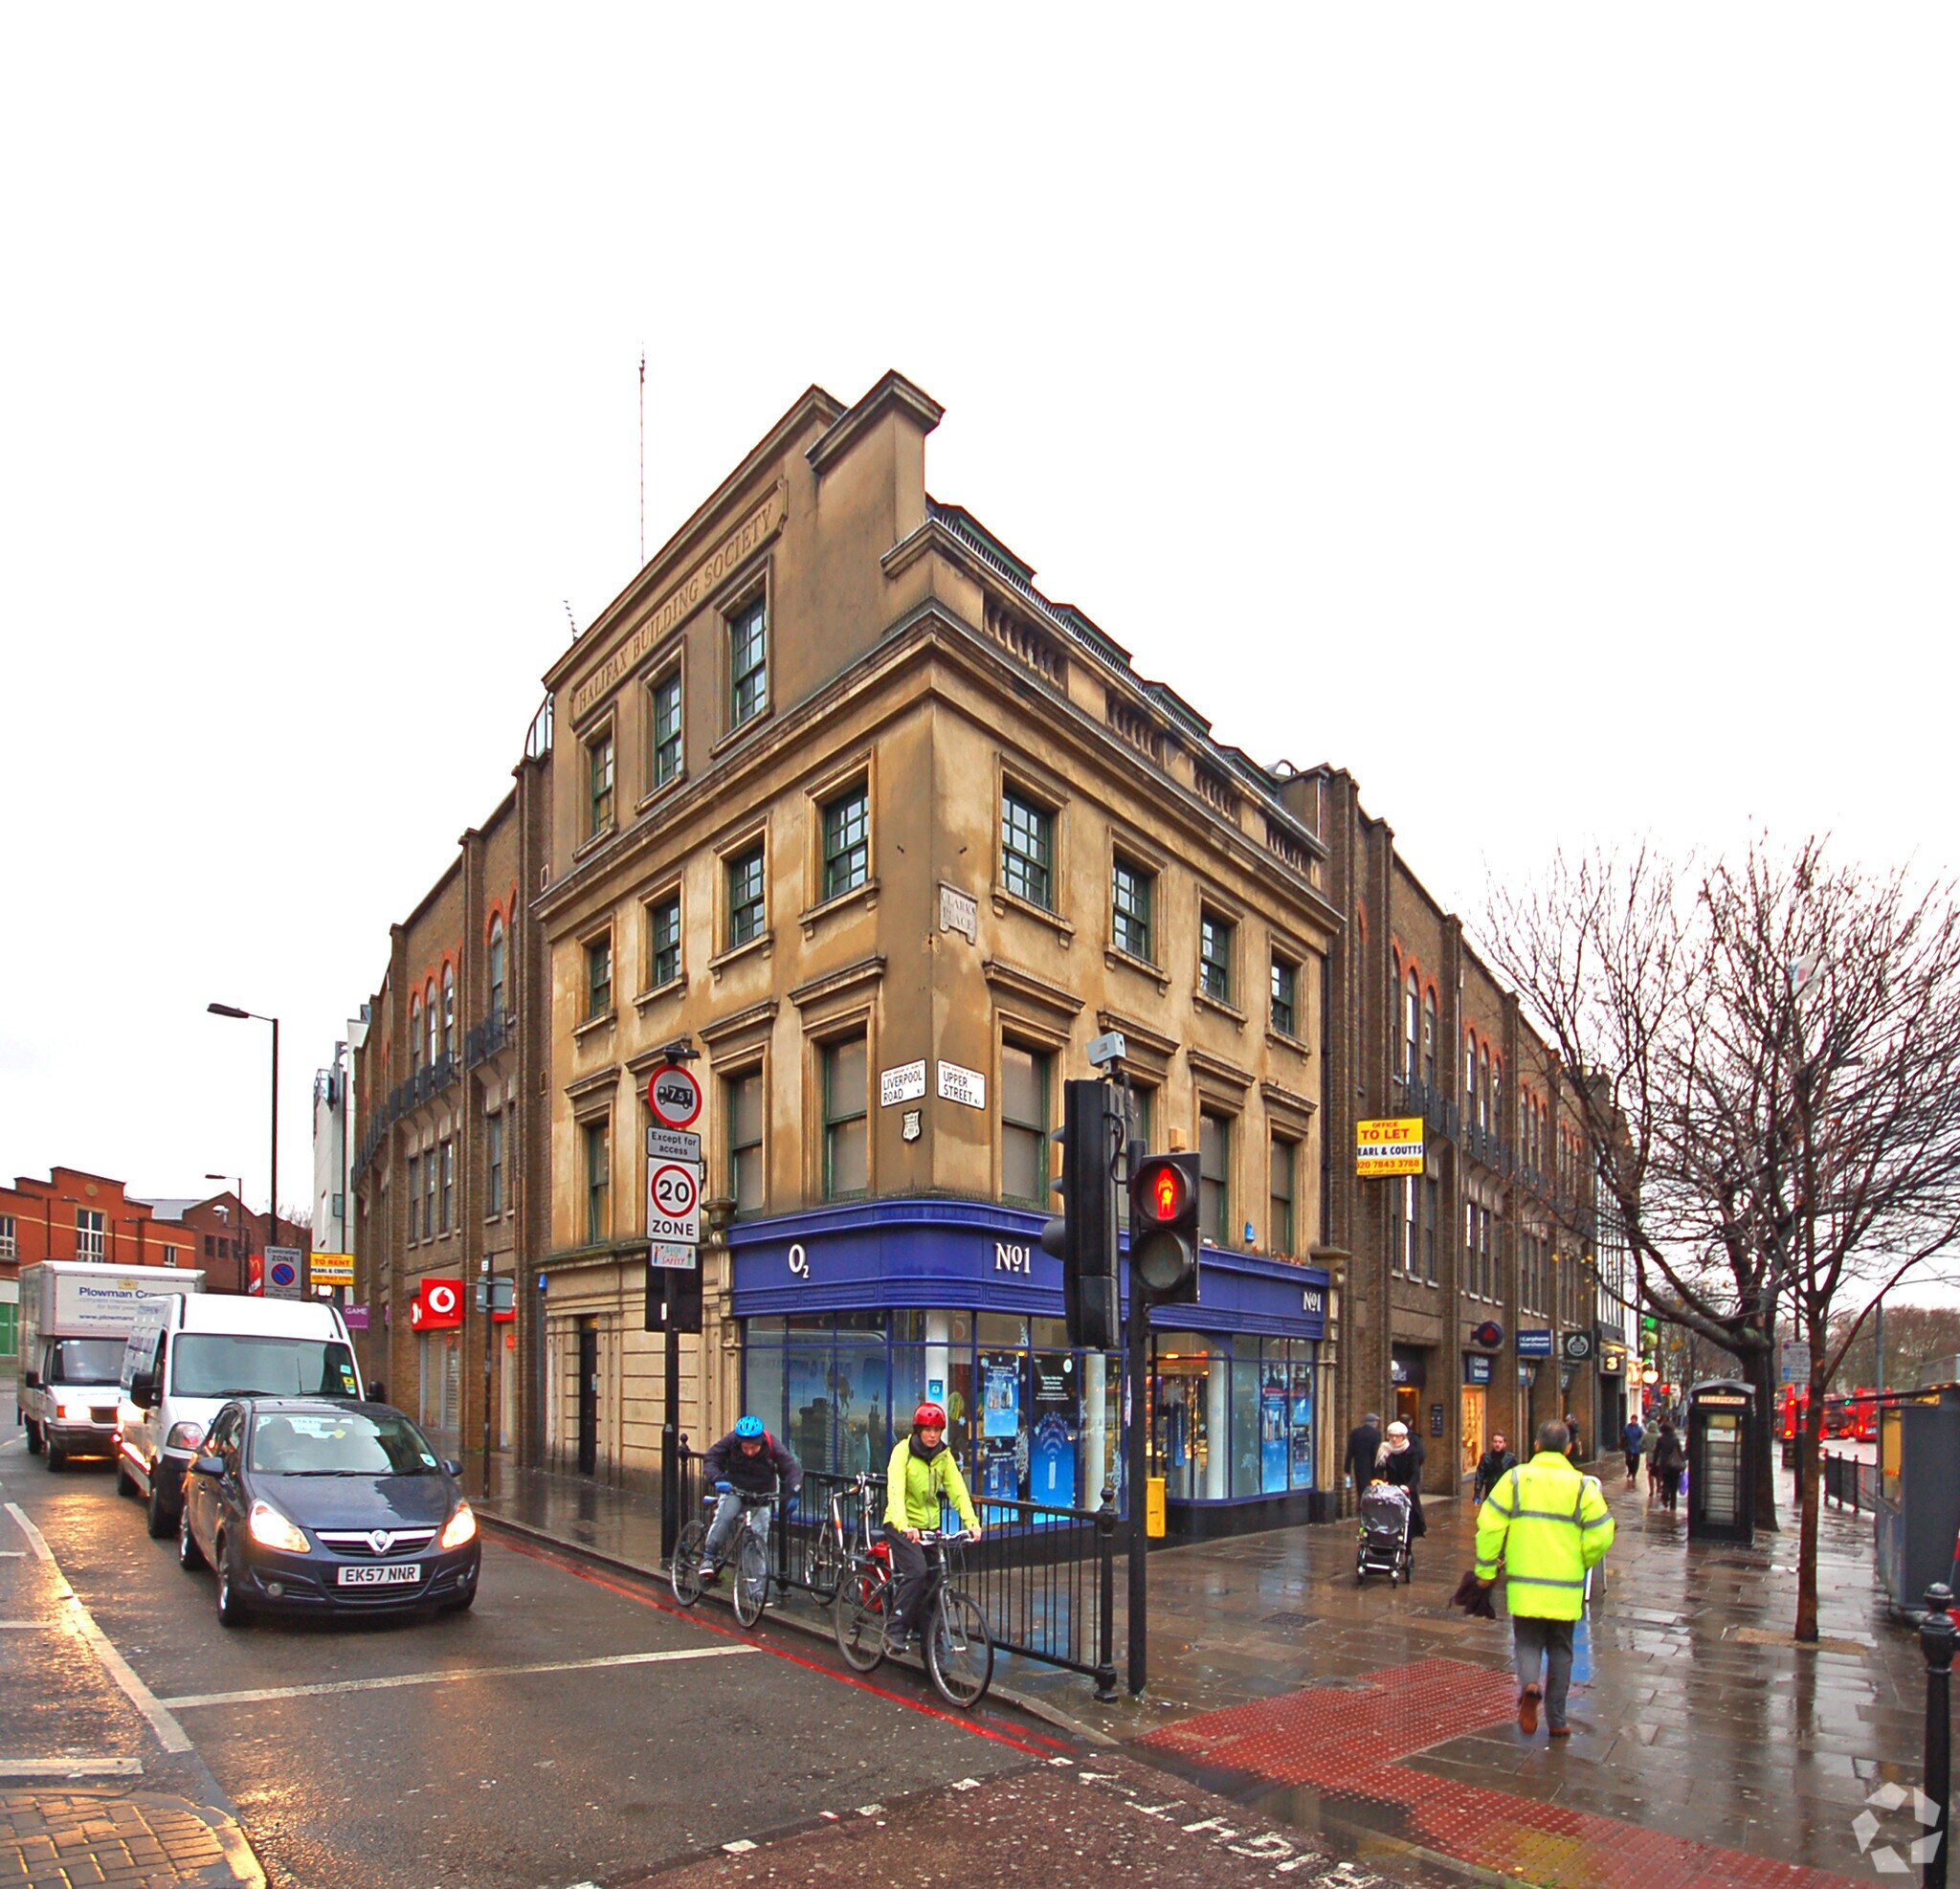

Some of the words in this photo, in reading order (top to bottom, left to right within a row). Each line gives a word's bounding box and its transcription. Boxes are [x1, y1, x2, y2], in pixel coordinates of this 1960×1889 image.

[579, 646, 630, 712] HALIFAX
[633, 578, 700, 660] BUILDING
[703, 503, 773, 589] SOCIETY
[882, 1070, 923, 1091] LIVERPOOL
[943, 1071, 968, 1088] UPPER
[882, 1088, 903, 1103] ROAD
[943, 1083, 973, 1103] STREET
[651, 1131, 682, 1145] Except
[684, 1137, 697, 1146] for
[1361, 1129, 1379, 1140] TO
[1384, 1128, 1410, 1140] LET
[658, 1145, 688, 1155] access
[1357, 1146, 1378, 1156] EARL
[1381, 1146, 1388, 1156] &
[1390, 1145, 1422, 1155] COUTTS
[1373, 1160, 1395, 1168] 7843
[658, 1179, 690, 1203] 20
[652, 1219, 694, 1236] ZONE
[78, 1287, 132, 1298] Plowman
[1606, 1356, 1618, 1370] 3
[345, 1567, 385, 1582] EK57
[388, 1567, 415, 1581] NNR
